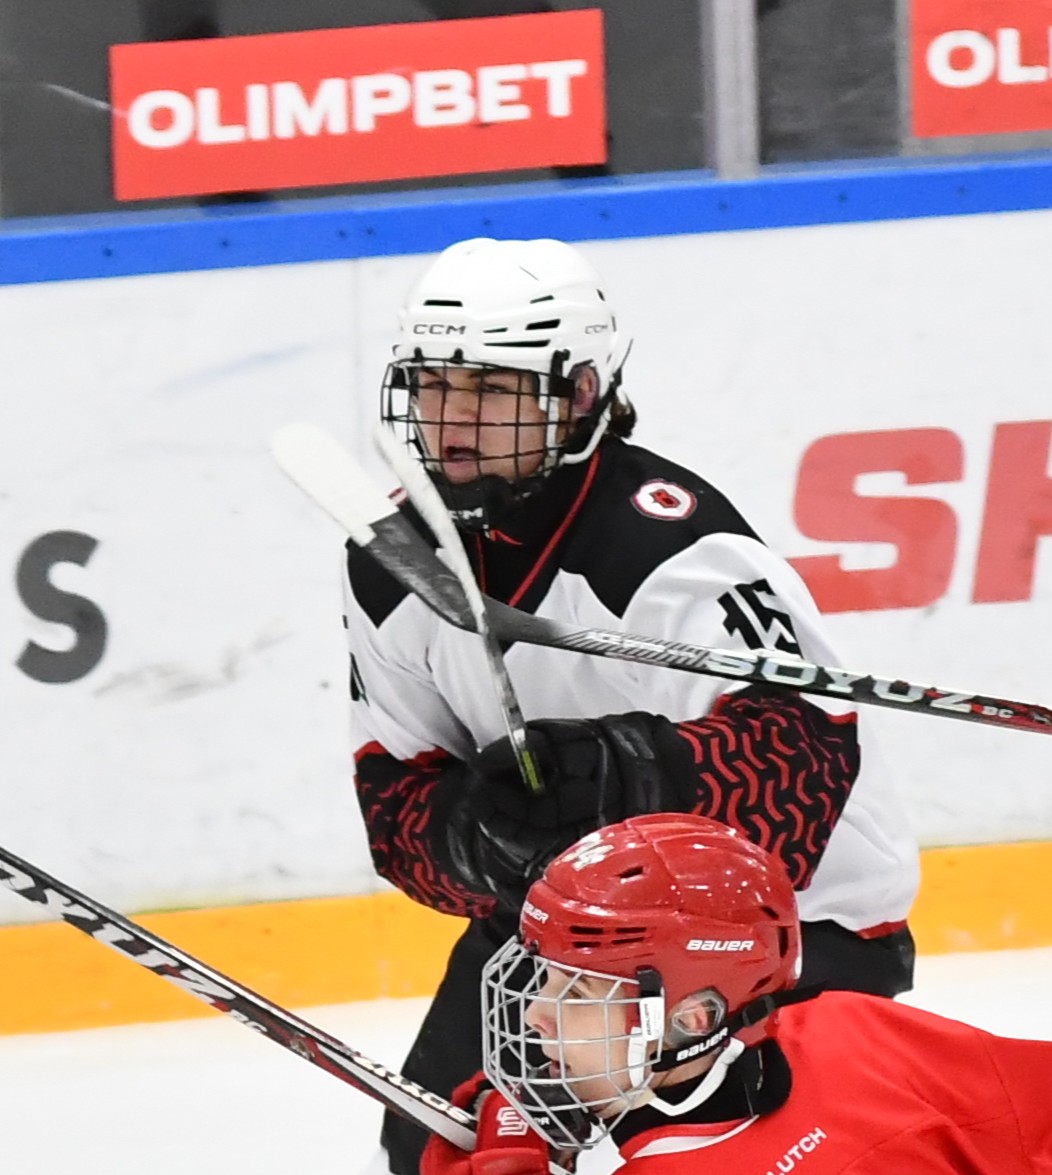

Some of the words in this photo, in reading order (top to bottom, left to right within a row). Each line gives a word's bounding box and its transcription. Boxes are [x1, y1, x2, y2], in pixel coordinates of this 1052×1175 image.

[127, 59, 587, 149] OLIMPBET
[412, 323, 467, 336] CCM
[14, 529, 108, 685] S
[716, 577, 805, 660] 15
[704, 648, 978, 716] SOYUZ
[685, 939, 755, 952] BAUER
[676, 1026, 729, 1062] BAUER
